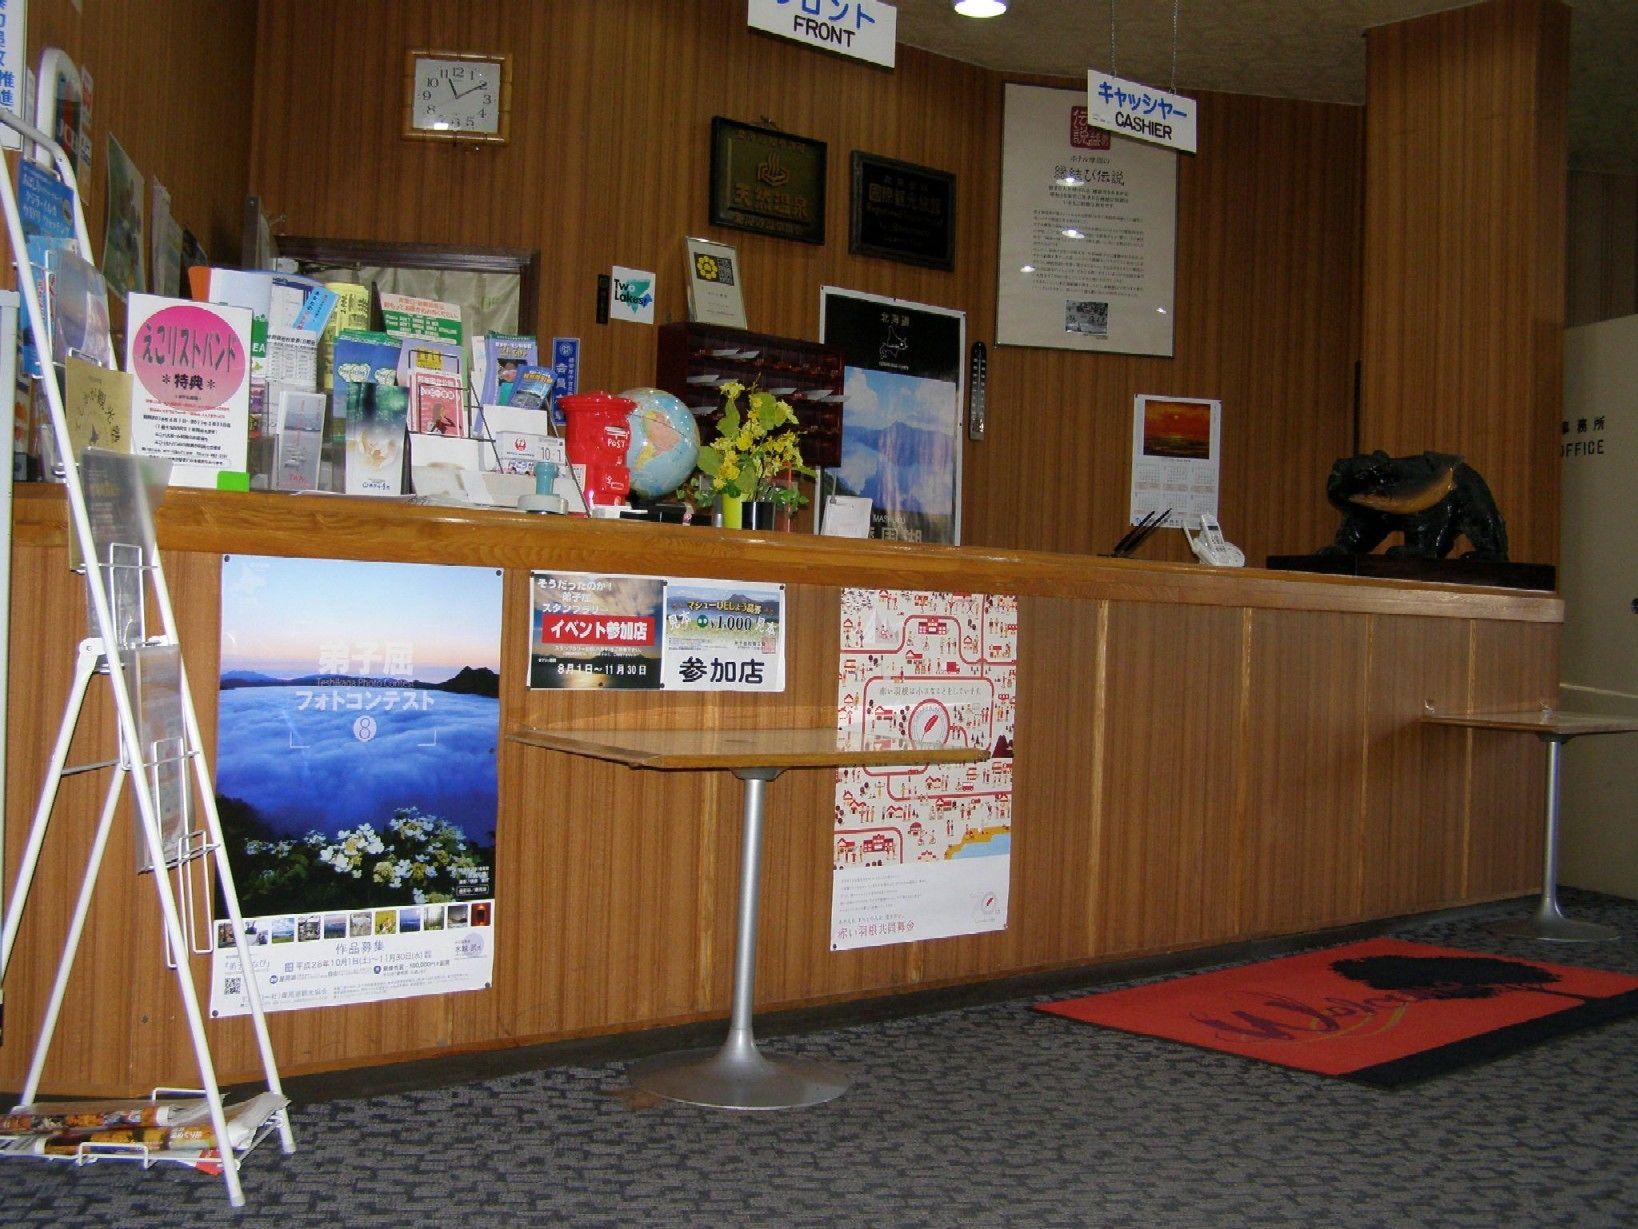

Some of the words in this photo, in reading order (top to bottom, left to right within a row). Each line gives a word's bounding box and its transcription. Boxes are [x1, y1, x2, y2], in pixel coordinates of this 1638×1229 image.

[777, 0, 876, 31] ロント
[793, 14, 856, 48] FRONT
[1098, 81, 1188, 120] キャッシャー
[1115, 111, 1172, 140] CASHIER
[614, 278, 636, 293] Two
[142, 323, 240, 373] えこリストバンド
[174, 373, 204, 391] 特典
[542, 603, 609, 614] スタンプラリー
[551, 619, 648, 641] イベント参加店
[317, 639, 414, 676] 弟子屈
[679, 656, 765, 684] 参加店
[296, 690, 436, 712] フォトコンテスト
[359, 717, 372, 740] 8
[335, 940, 385, 955] 作品募集
